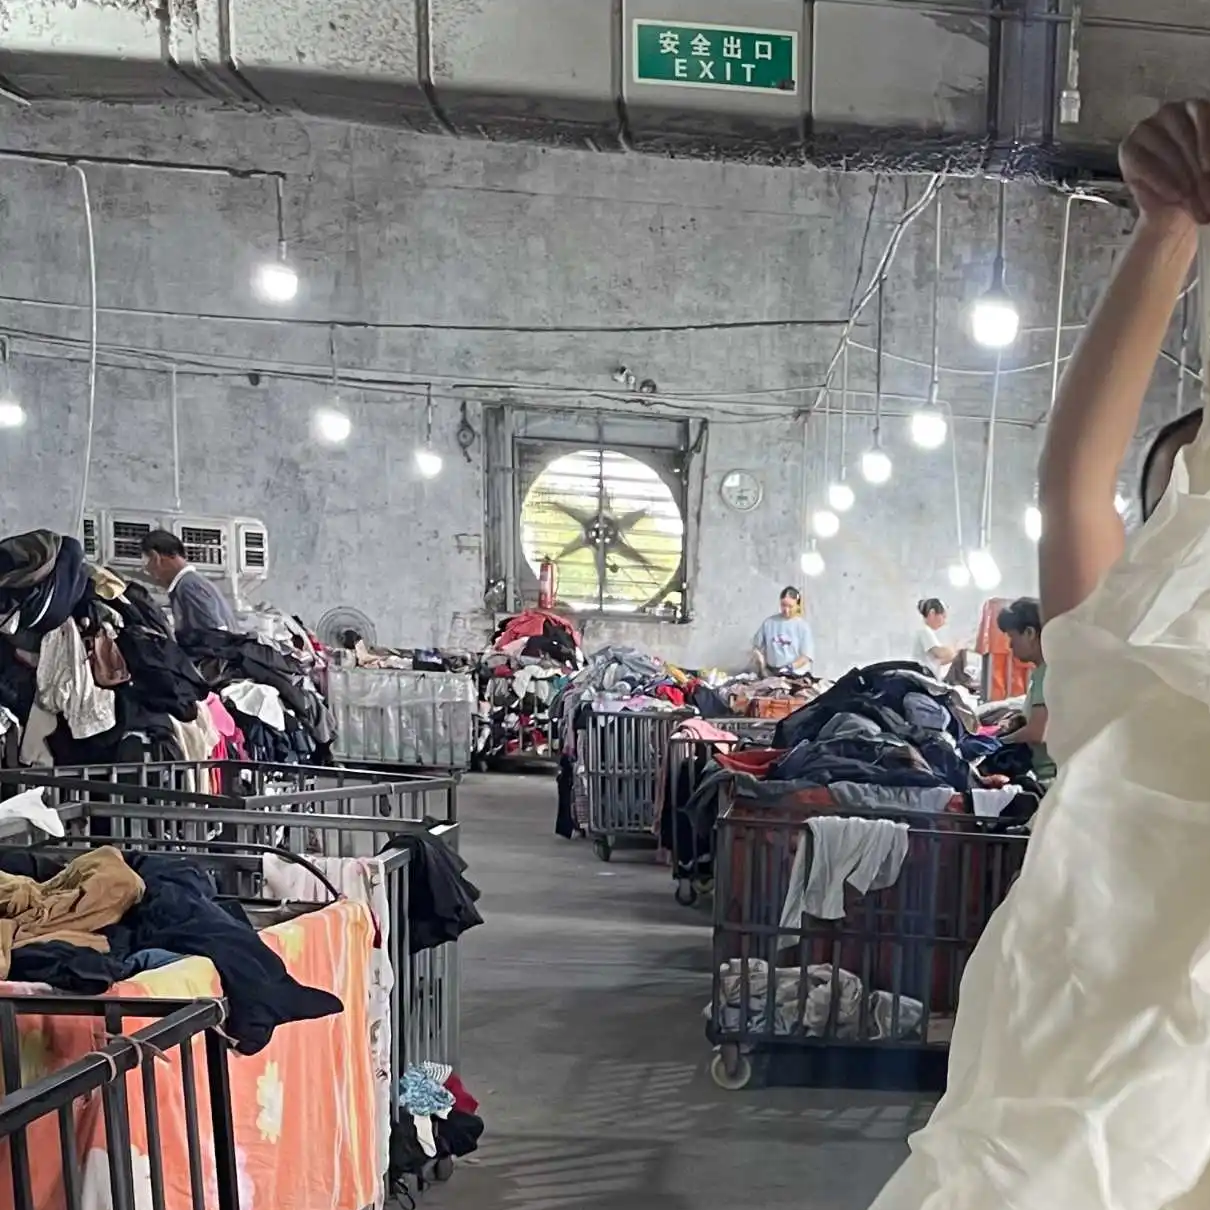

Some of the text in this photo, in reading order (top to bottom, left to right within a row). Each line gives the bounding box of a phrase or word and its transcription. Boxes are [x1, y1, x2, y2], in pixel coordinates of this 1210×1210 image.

[659, 31, 772, 60] 安全出口
[674, 58, 756, 82] EXIT
